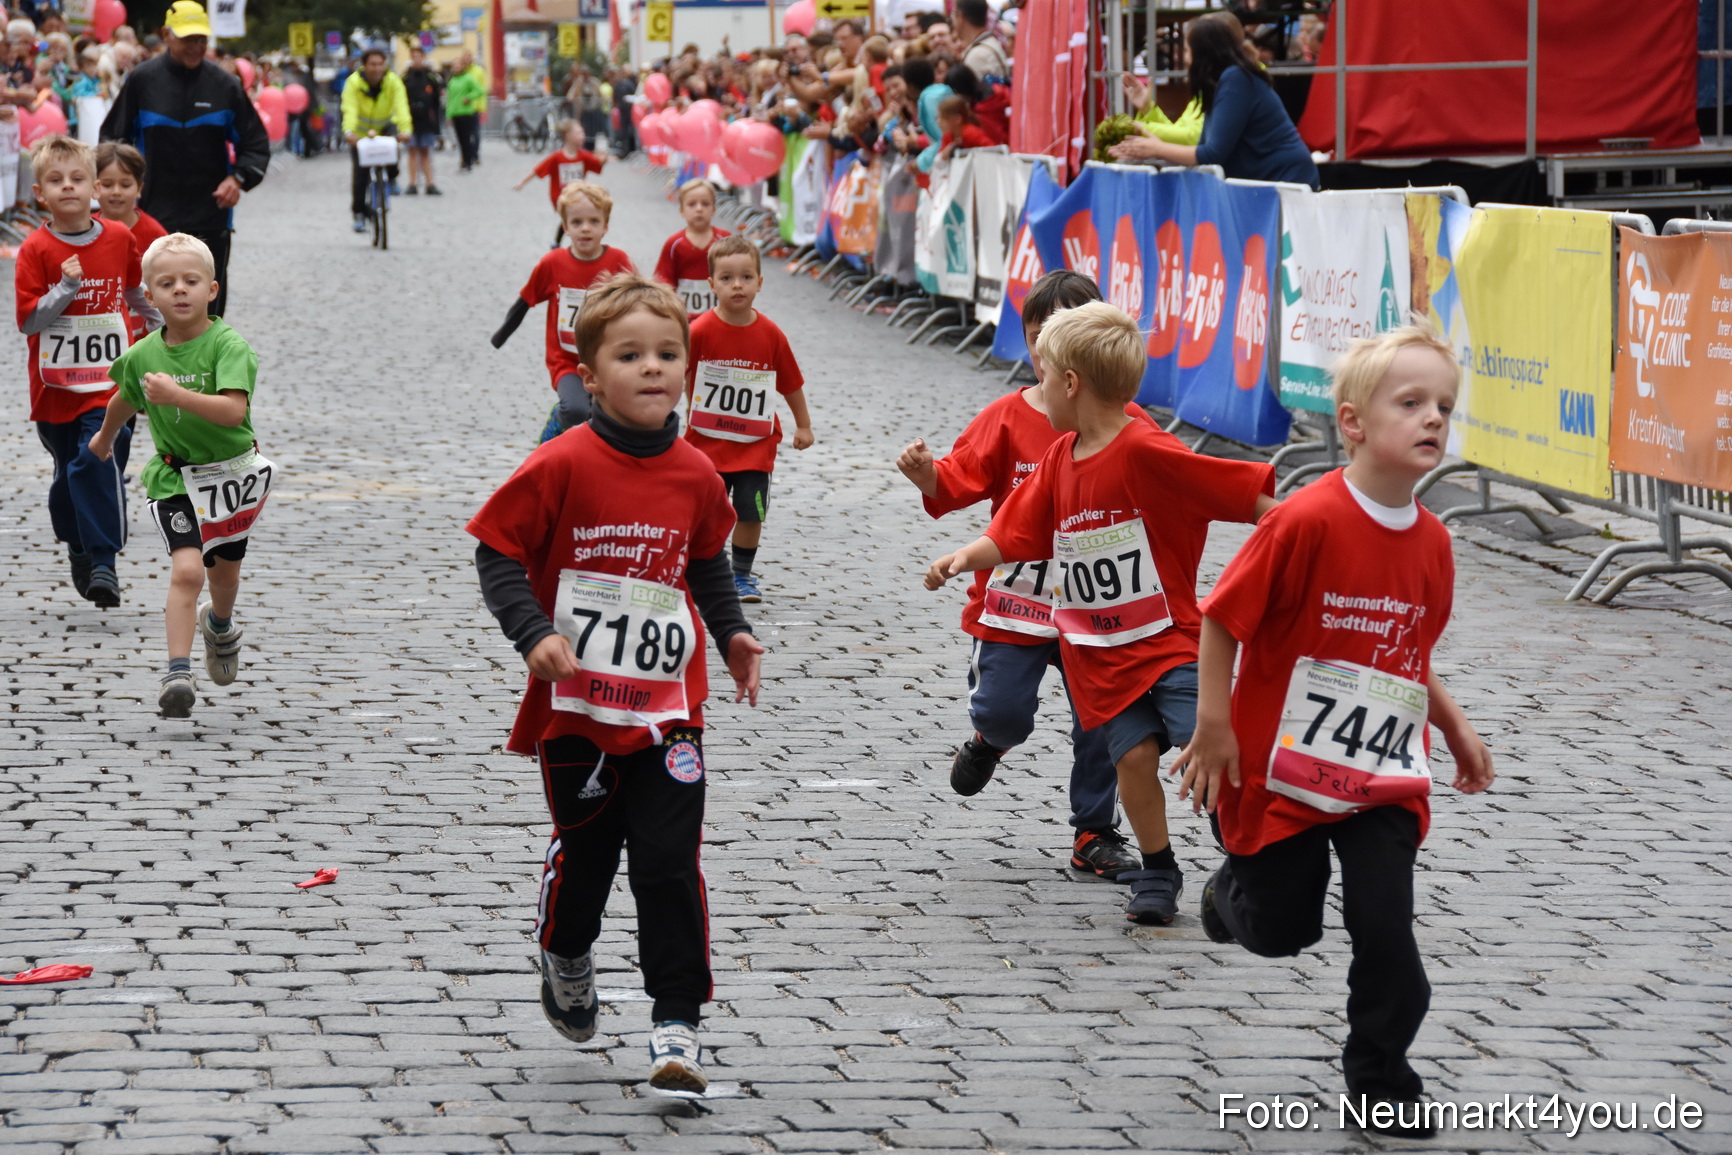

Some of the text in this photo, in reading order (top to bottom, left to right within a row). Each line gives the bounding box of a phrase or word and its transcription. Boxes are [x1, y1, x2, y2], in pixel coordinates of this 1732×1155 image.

[1660, 292, 1691, 327] CODE
[49, 333, 121, 364] 7160
[1652, 331, 1692, 367] CLINIC
[66, 371, 103, 383] Moritz
[704, 381, 767, 416] 7001
[716, 418, 746, 432] Anton
[198, 465, 272, 518] 7027
[1076, 525, 1136, 550] BOCK
[1060, 548, 1141, 603] 7097
[571, 586, 621, 601] NeuerMarkt
[632, 584, 678, 611] BOCK
[1323, 592, 1412, 615] Neumarkter
[1090, 613, 1123, 631] Max
[1322, 613, 1396, 638] Stadtlauf
[572, 607, 686, 674] 7189
[589, 679, 651, 710] Philipp
[1307, 671, 1359, 691] NeuerMarkt
[1369, 675, 1427, 710] BOCK
[1301, 691, 1416, 769] 7444
[578, 788, 607, 799] adidas
[1309, 762, 1371, 797] Felix
